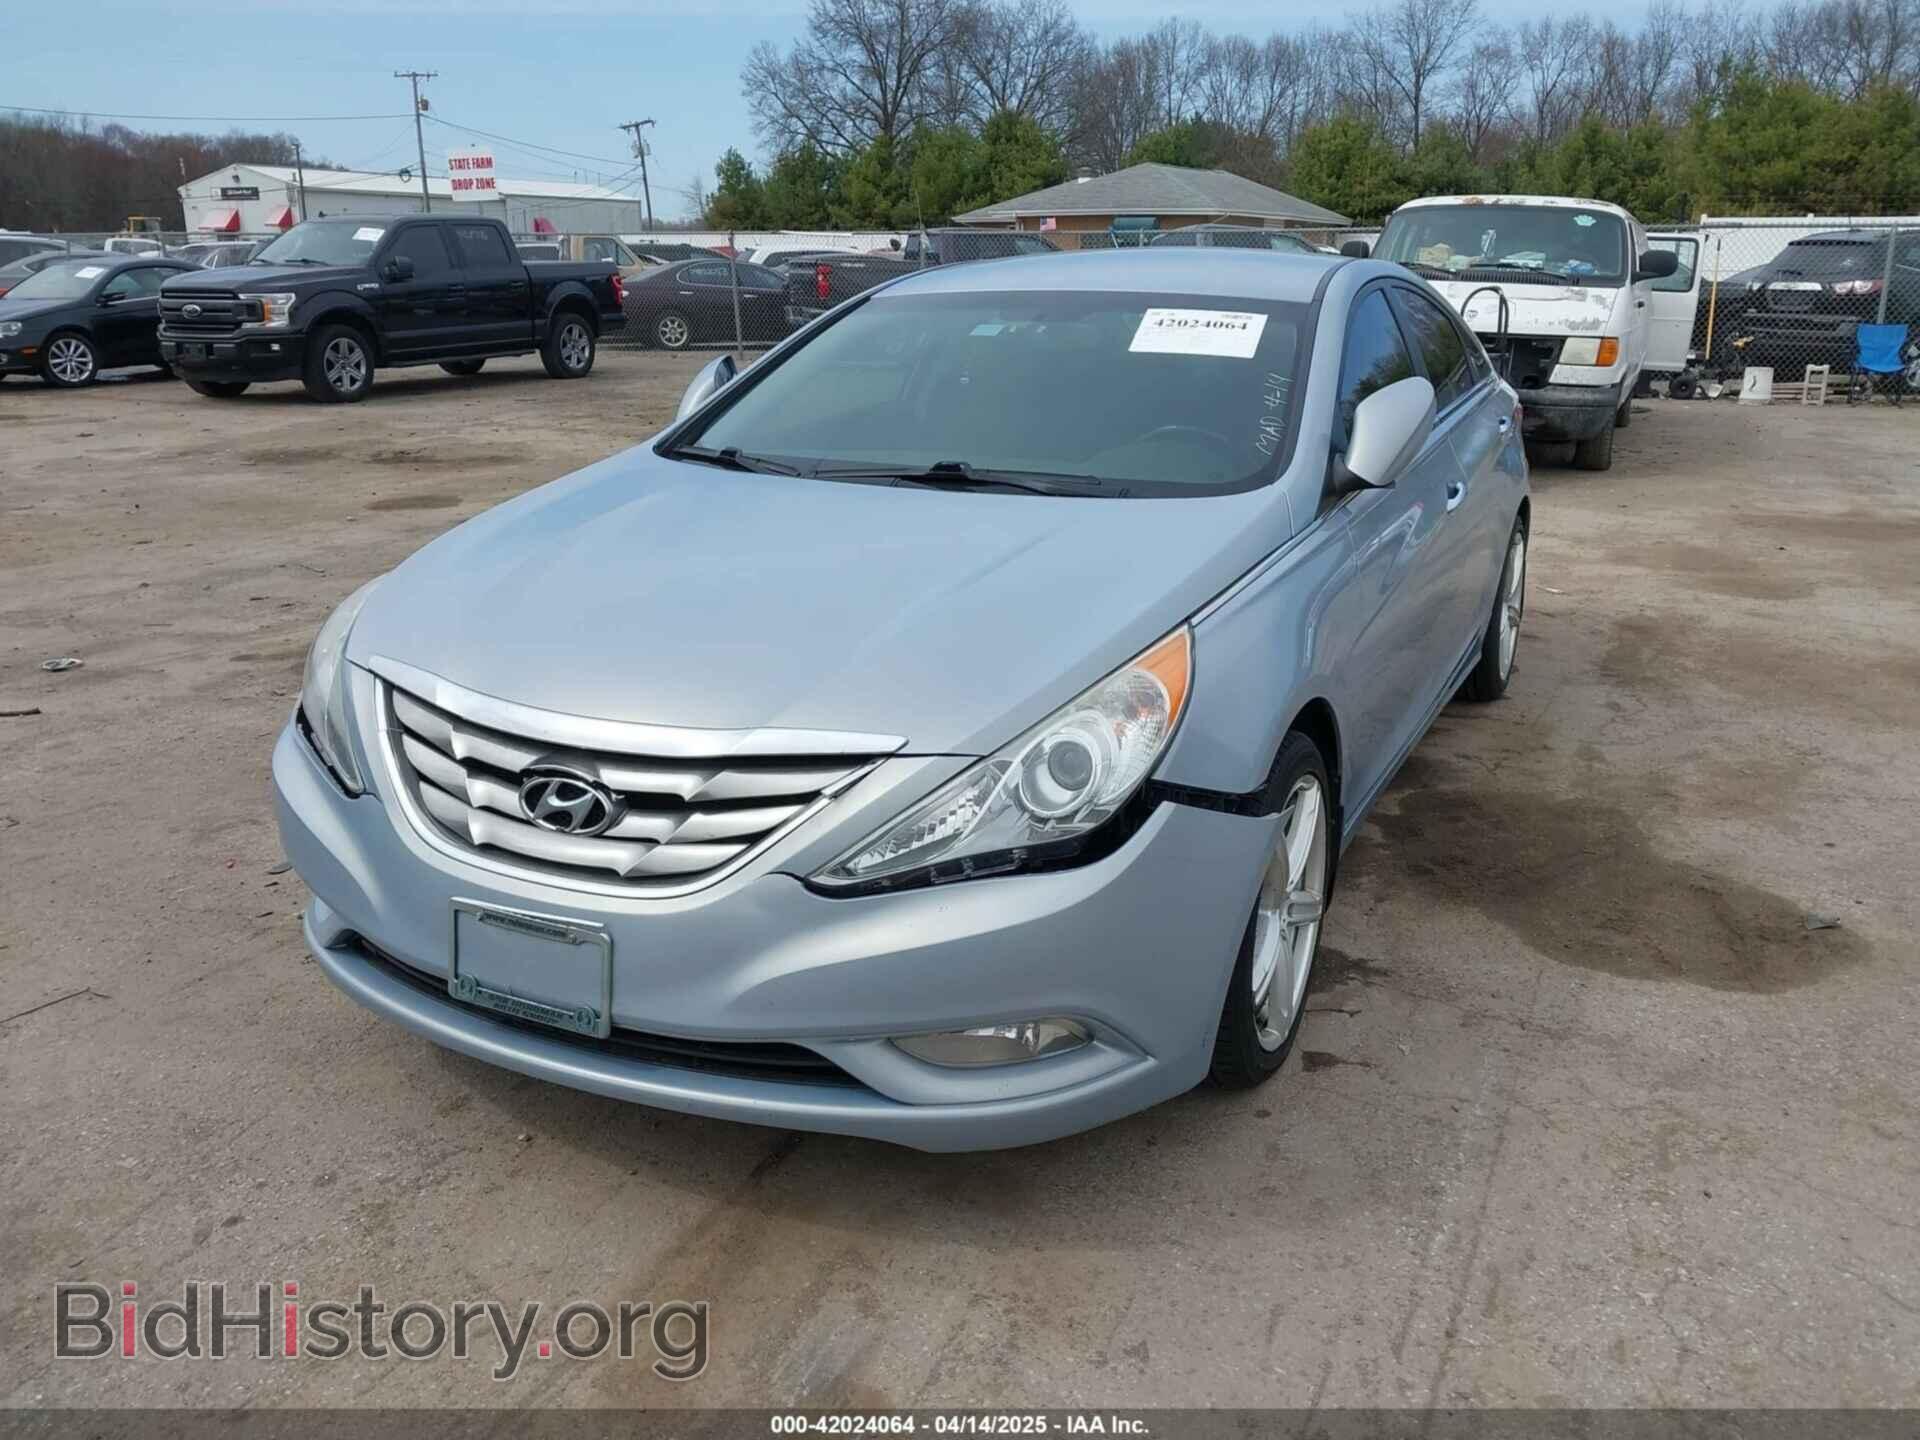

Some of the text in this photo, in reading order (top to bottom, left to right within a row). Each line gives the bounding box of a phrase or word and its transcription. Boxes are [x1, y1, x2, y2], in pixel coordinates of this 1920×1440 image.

[448, 156, 493, 170] STATE FARM
[451, 177, 496, 190] DROP ZONE
[1153, 318, 1248, 330] 42024064
